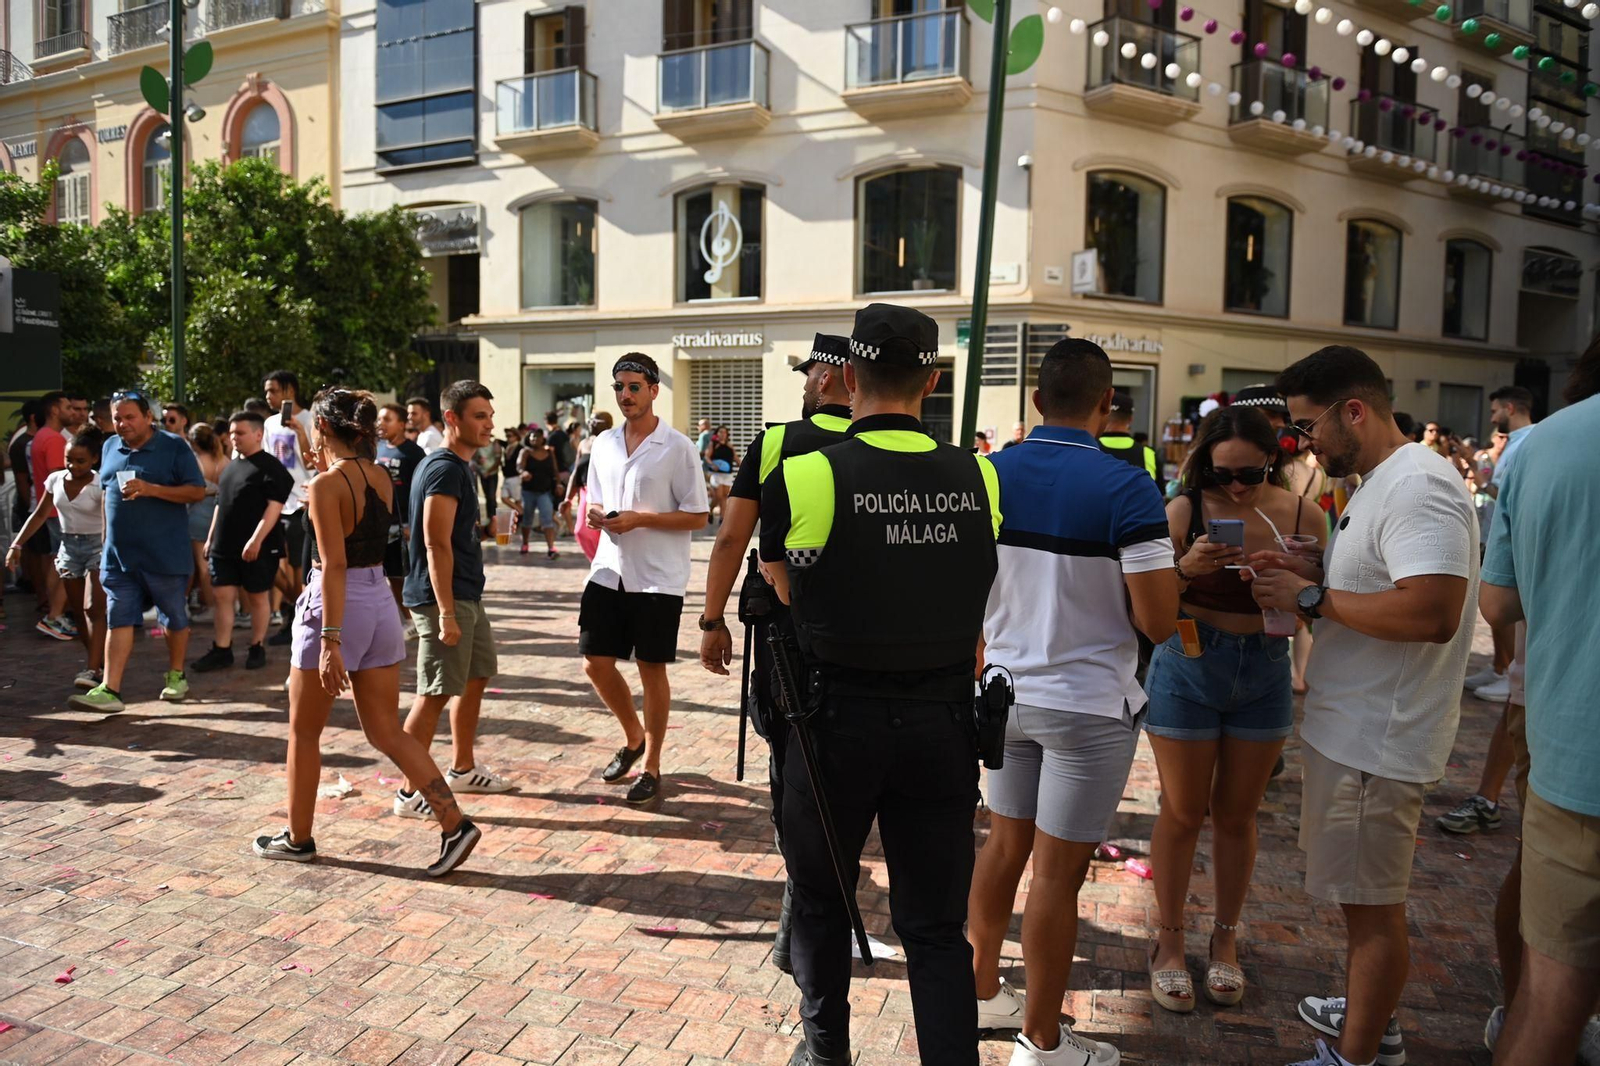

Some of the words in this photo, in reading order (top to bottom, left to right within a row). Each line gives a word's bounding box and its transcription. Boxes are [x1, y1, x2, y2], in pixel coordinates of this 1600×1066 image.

[672, 328, 763, 347] stradivarius
[853, 489, 922, 514] POLICÍA
[925, 491, 981, 513] LOCAL
[886, 520, 959, 544] MÁLAGA
